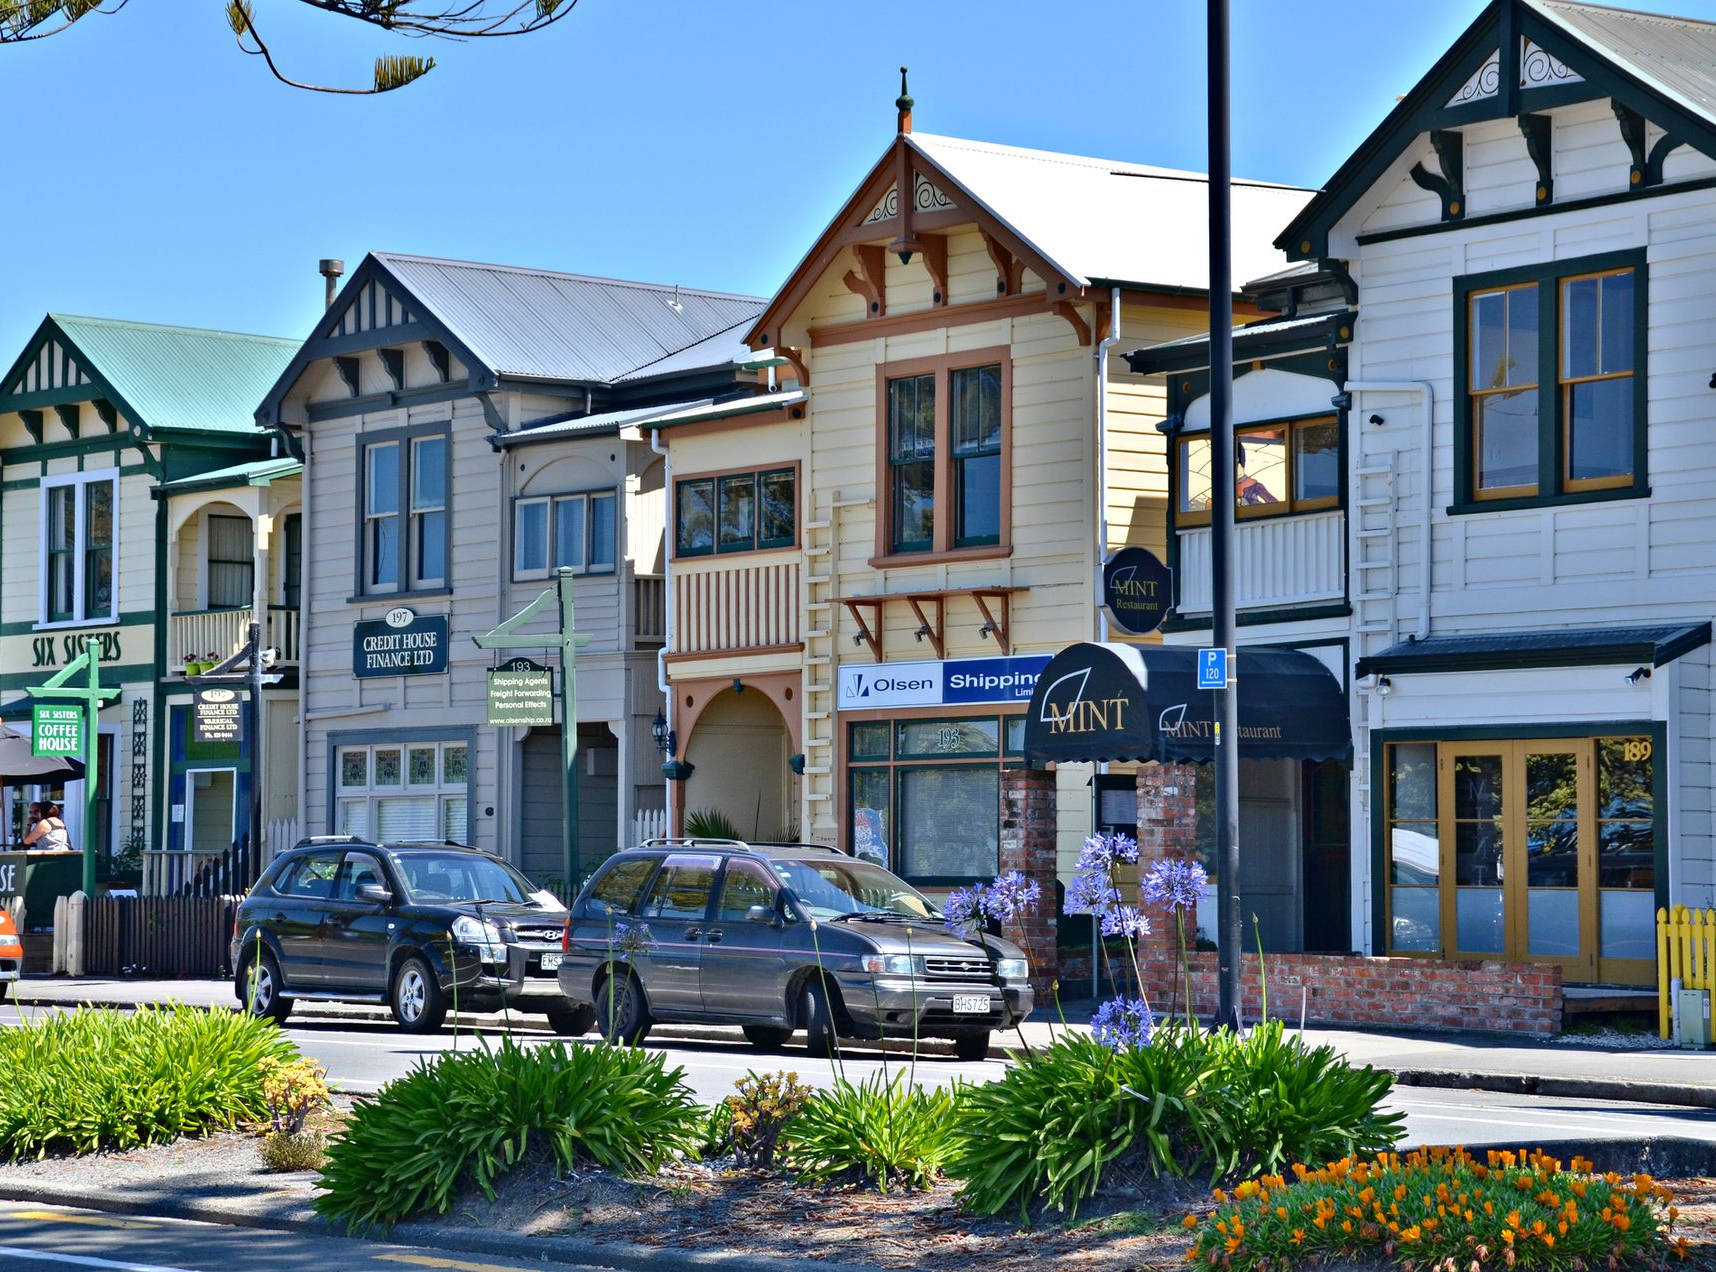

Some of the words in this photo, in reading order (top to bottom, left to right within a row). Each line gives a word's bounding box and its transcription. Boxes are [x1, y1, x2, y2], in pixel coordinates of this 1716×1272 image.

[1114, 579, 1158, 597] MINT
[1116, 599, 1159, 611] Restaurant
[392, 611, 407, 624] 197
[363, 635, 400, 652] CREDIT
[402, 632, 437, 649] HOUSE
[32, 636, 57, 667] SIX
[366, 651, 411, 669] FINANCE
[413, 649, 434, 666] LTD
[1207, 651, 1217, 666] P
[510, 661, 531, 672] 193
[1205, 668, 1220, 679] 120
[493, 678, 523, 687] Shipping
[524, 677, 548, 687] Agents
[873, 678, 933, 692] Olsen
[490, 690, 513, 699] Freight
[514, 689, 551, 698] Forwarding
[1015, 687, 1034, 698] Limi
[495, 701, 524, 709] Personal
[524, 700, 547, 708] Effects
[39, 710, 50, 719] SIX
[52, 710, 78, 719] SISTERS
[489, 717, 553, 725] www.olsenship.co.nz
[1048, 698, 1129, 734] MINT
[38, 724, 78, 737] COFFEE
[1164, 720, 1212, 738] MINT
[1237, 725, 1282, 738] taurant
[38, 737, 78, 751] HOUSE
[937, 727, 961, 750] 193
[1624, 741, 1652, 761] 189
[542, 956, 562, 967] EMS
[954, 997, 989, 1011] BHS725
